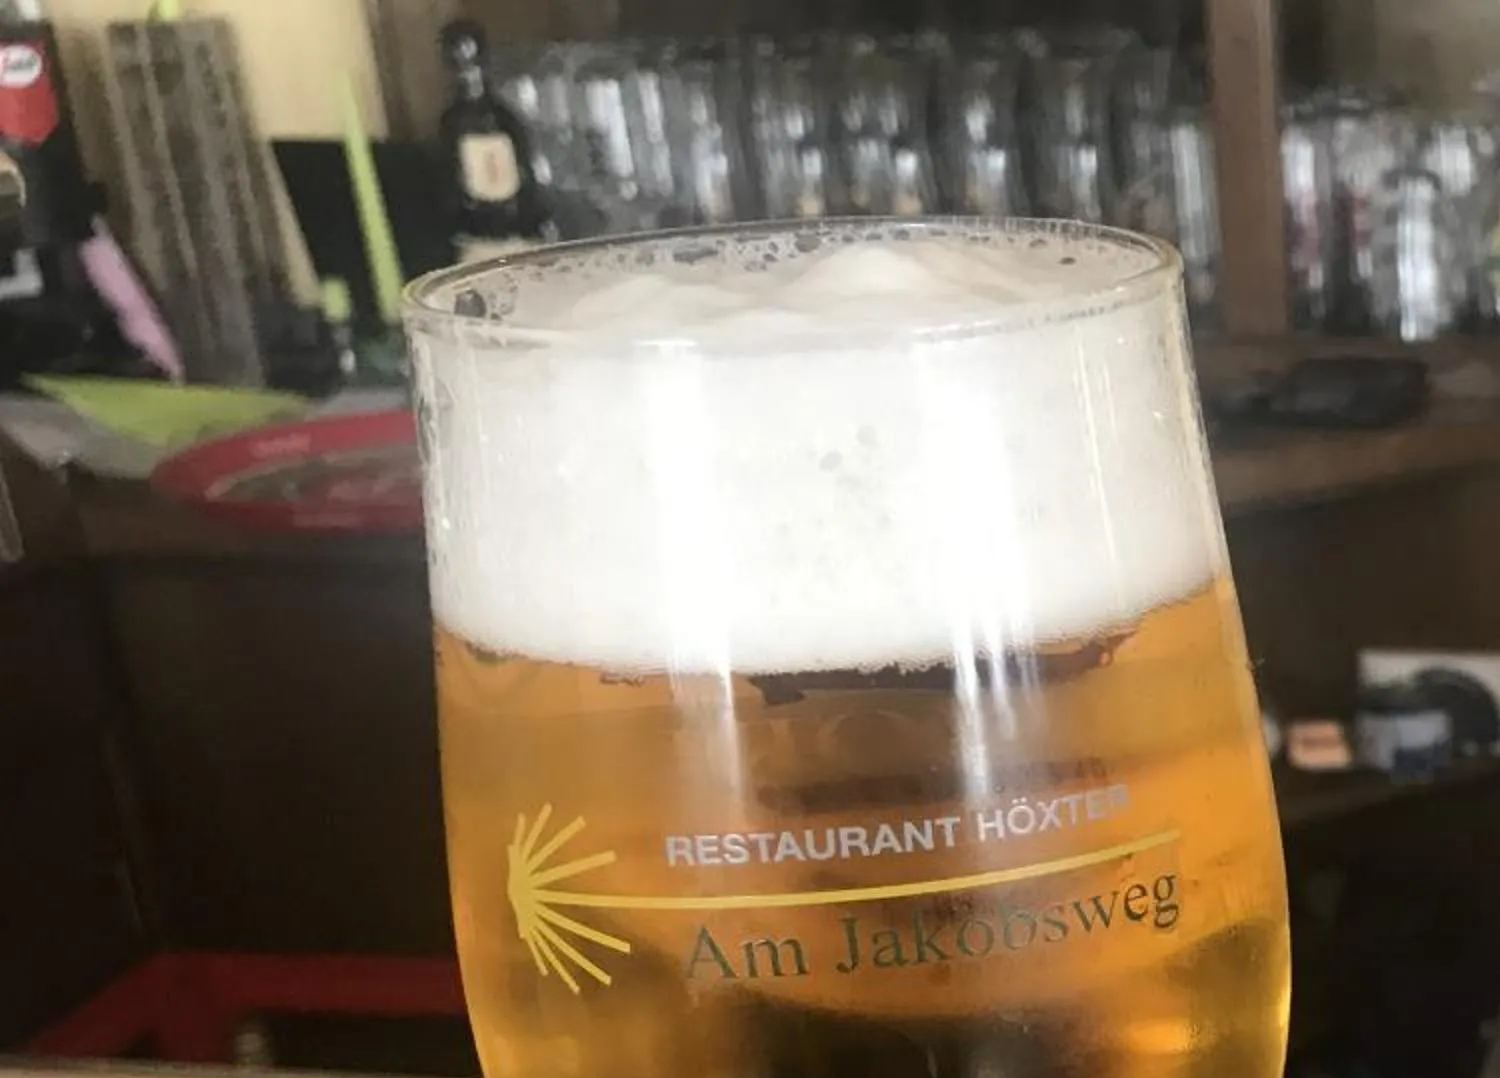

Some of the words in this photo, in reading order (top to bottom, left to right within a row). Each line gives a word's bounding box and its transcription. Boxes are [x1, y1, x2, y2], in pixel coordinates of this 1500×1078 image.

[665, 815, 961, 867] RESTAURANT
[976, 783, 1131, 842] HÖXTER
[685, 922, 809, 980] Am
[836, 873, 1180, 975] Jakobsweg
